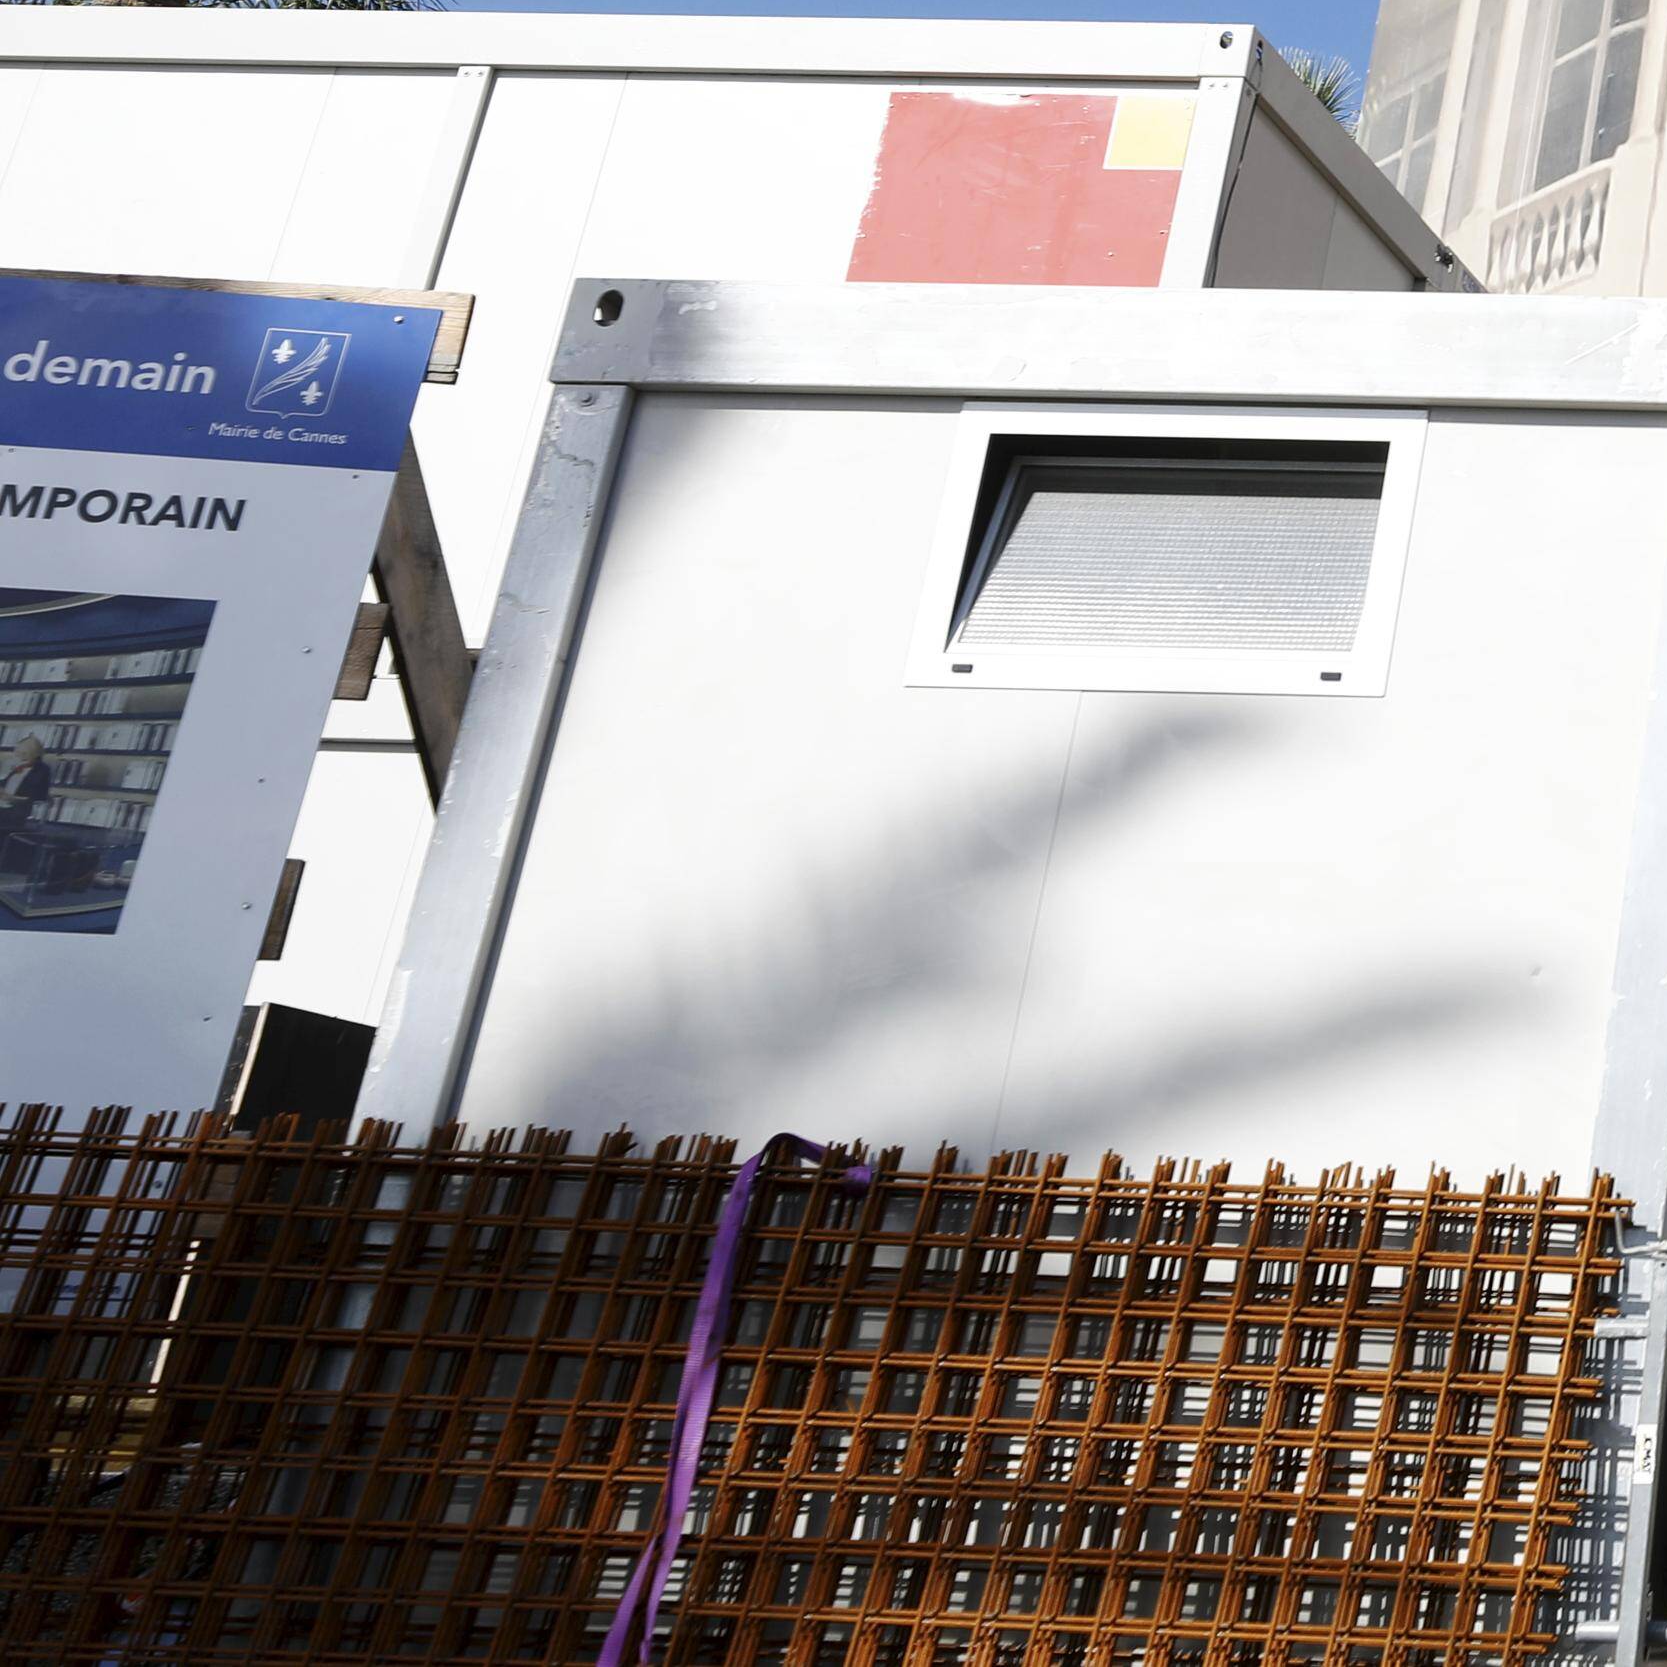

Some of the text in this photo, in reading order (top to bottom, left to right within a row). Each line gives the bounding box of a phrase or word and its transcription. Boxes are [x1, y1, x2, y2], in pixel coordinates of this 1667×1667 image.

[3, 339, 216, 394] demain
[208, 421, 348, 445] Mairie de Cannes
